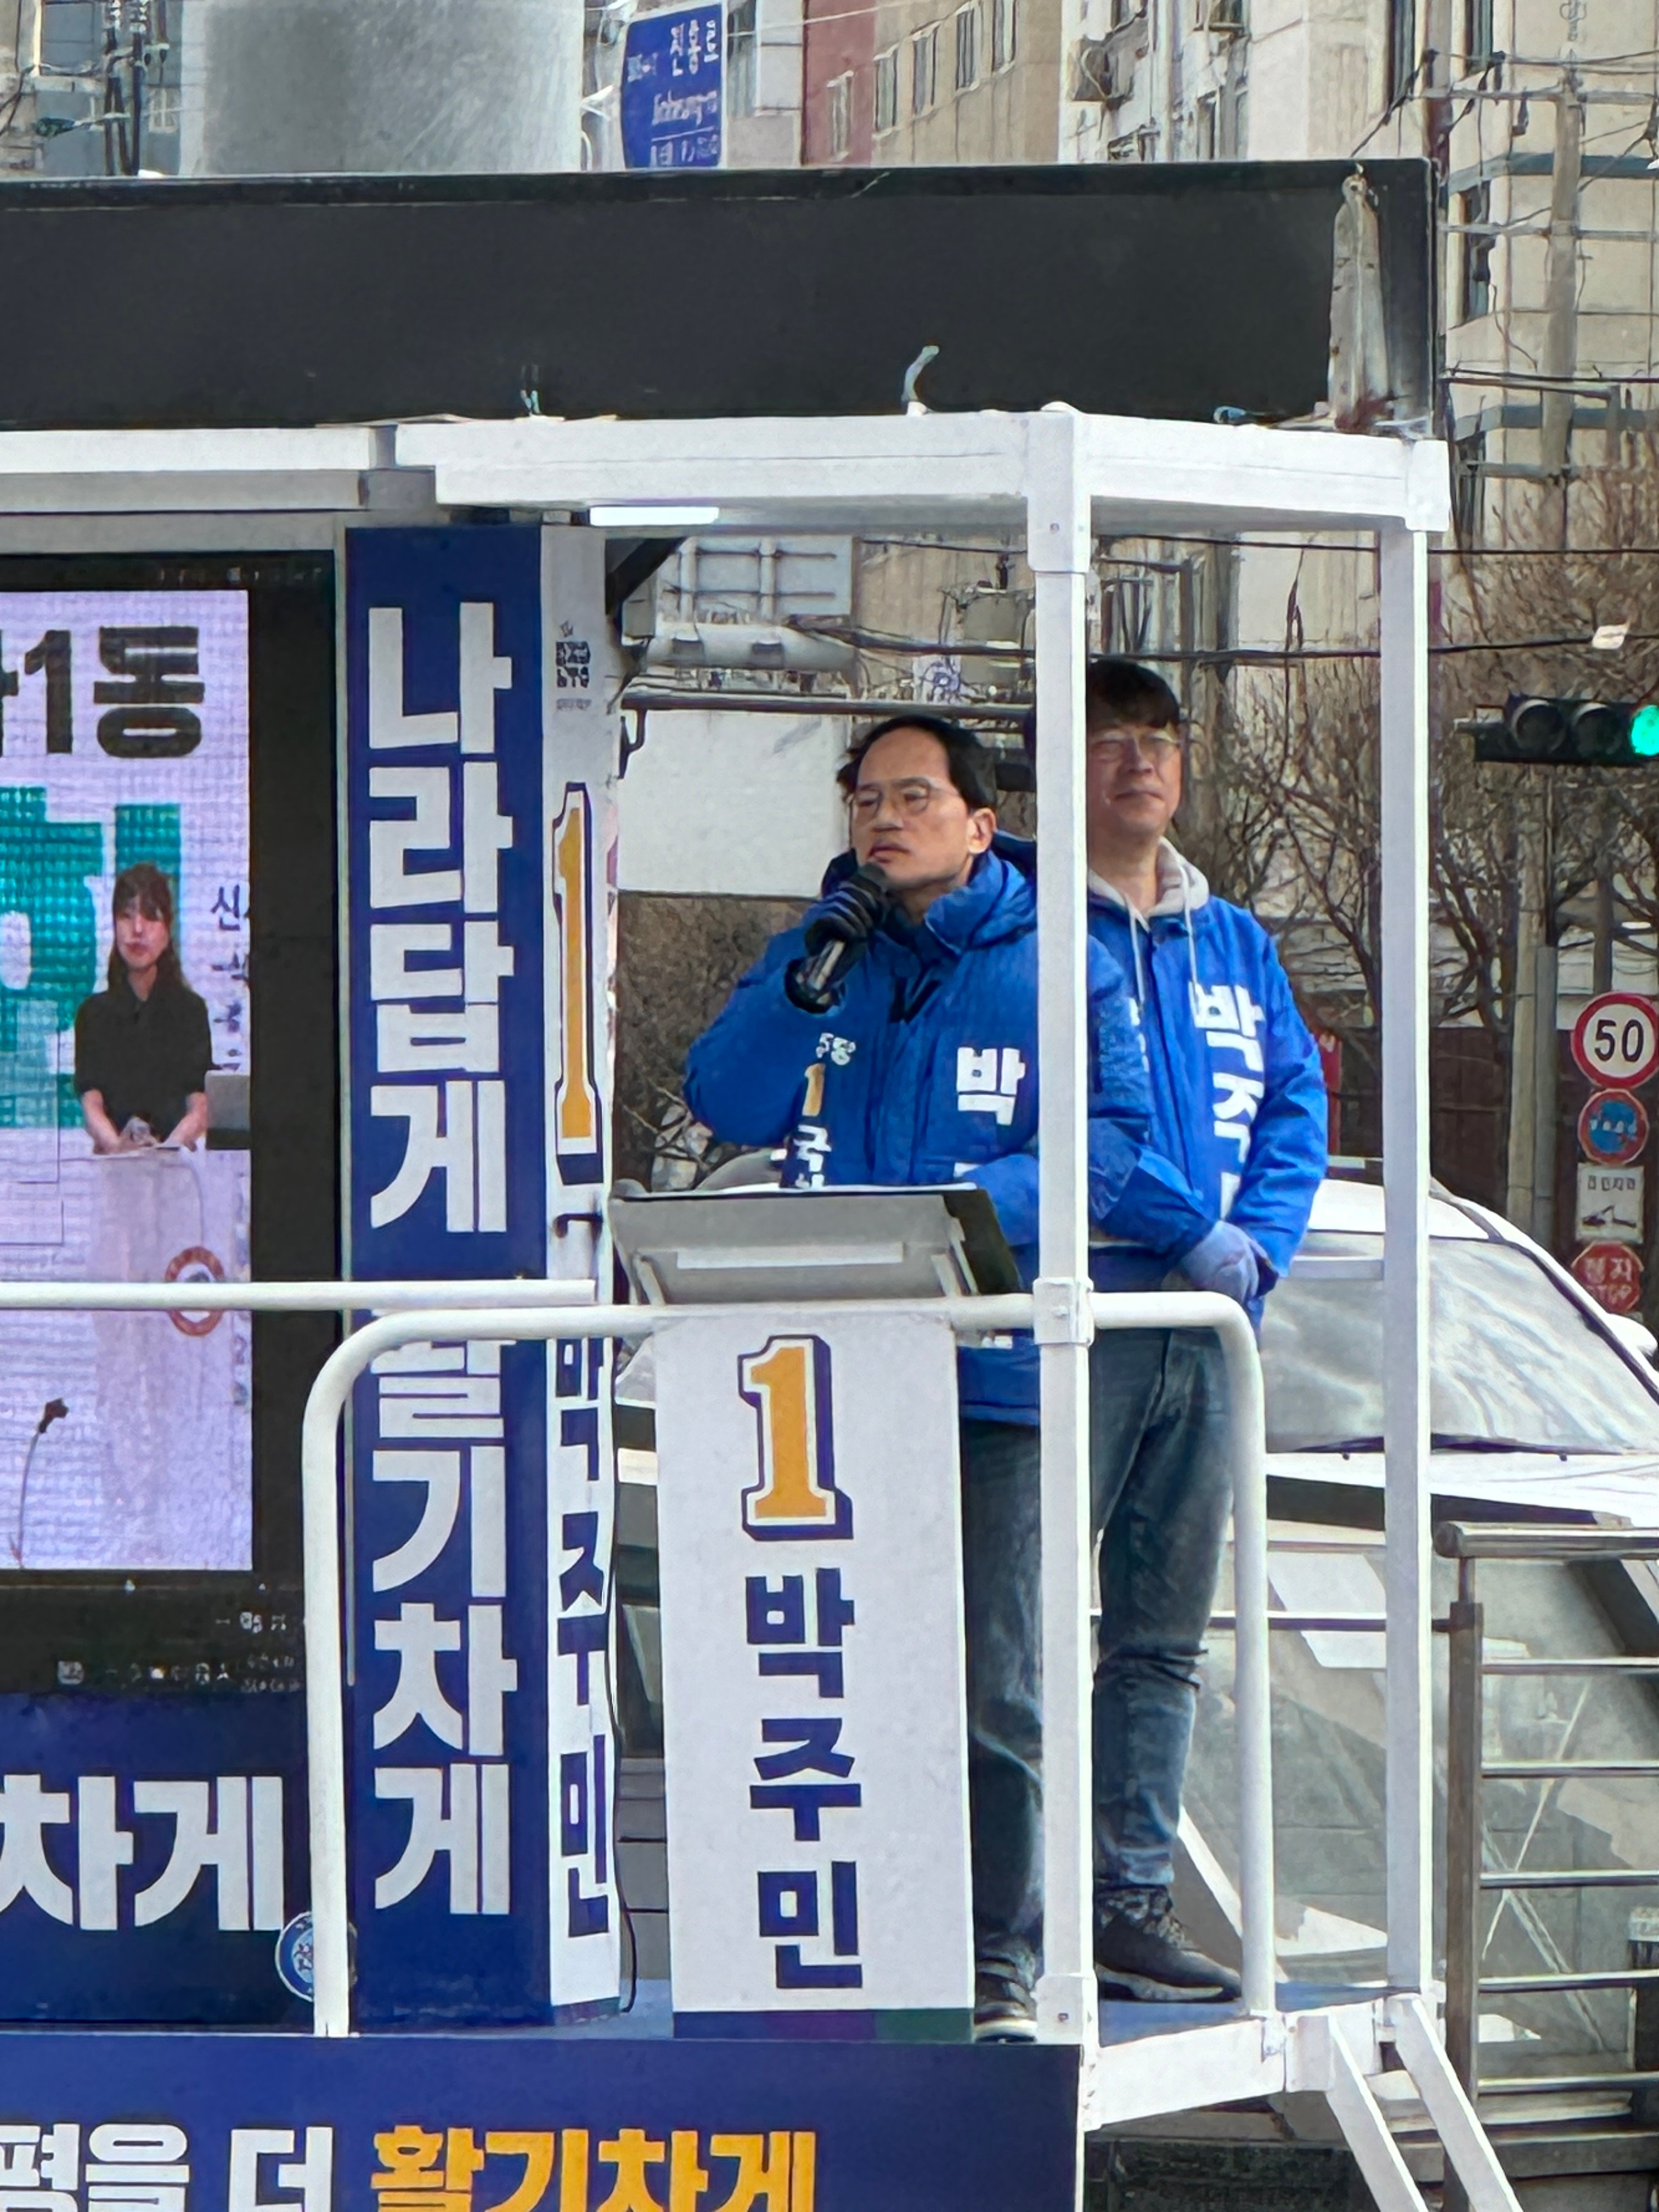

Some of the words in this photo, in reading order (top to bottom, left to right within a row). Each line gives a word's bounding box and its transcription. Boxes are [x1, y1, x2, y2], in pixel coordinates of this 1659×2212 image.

[0, 625, 205, 758] 1동
[211, 884, 250, 932] 신
[368, 601, 515, 1233] 나라답게
[802, 1062, 826, 1117] 1
[1594, 1018, 1644, 1063] 50
[737, 1334, 854, 1541] 1
[745, 1566, 864, 1990] 박주민
[0, 1775, 284, 1932] 차게
[369, 2125, 817, 2212] 활기차게
